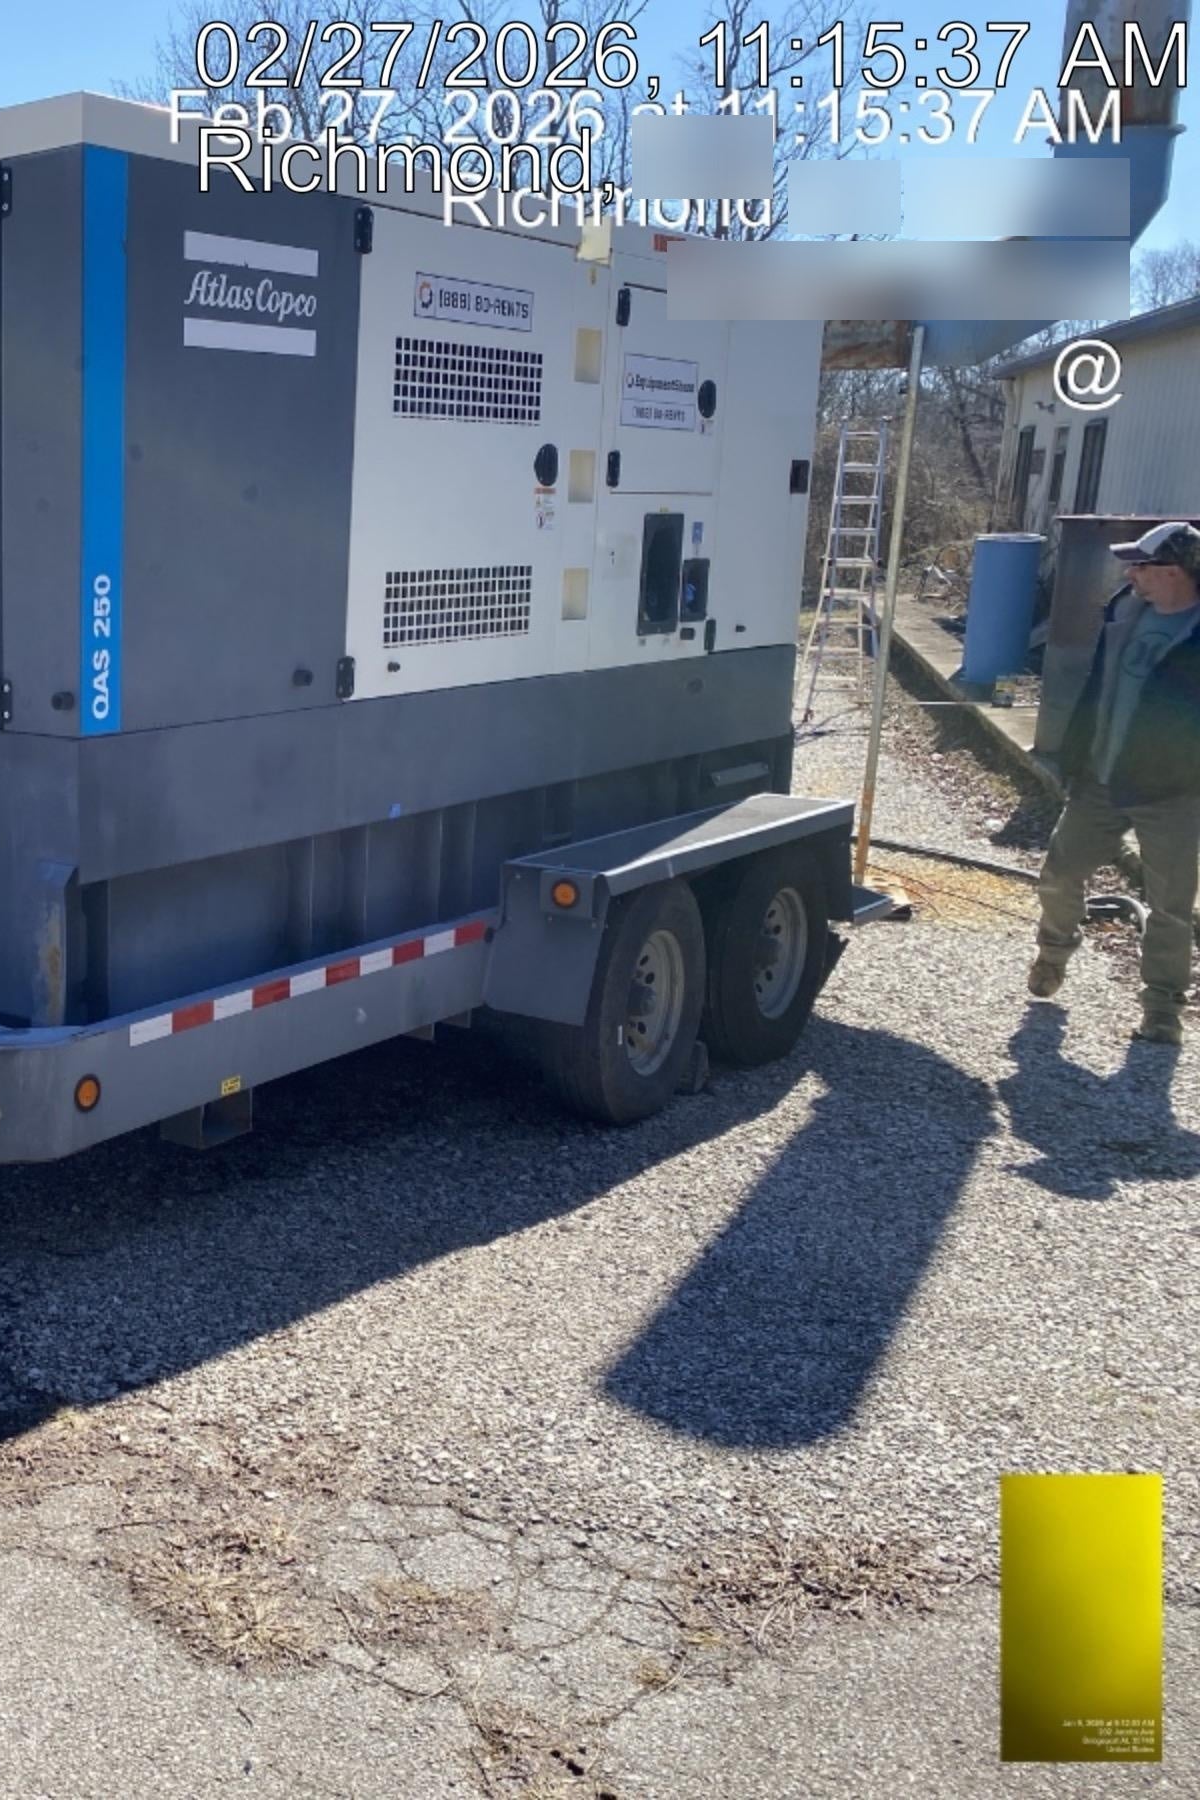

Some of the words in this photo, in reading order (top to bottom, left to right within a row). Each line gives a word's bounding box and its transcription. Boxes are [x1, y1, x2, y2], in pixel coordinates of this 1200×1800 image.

[184, 270, 255, 311] Atlas
[256, 278, 317, 323] Copco
[93, 574, 112, 638] 250
